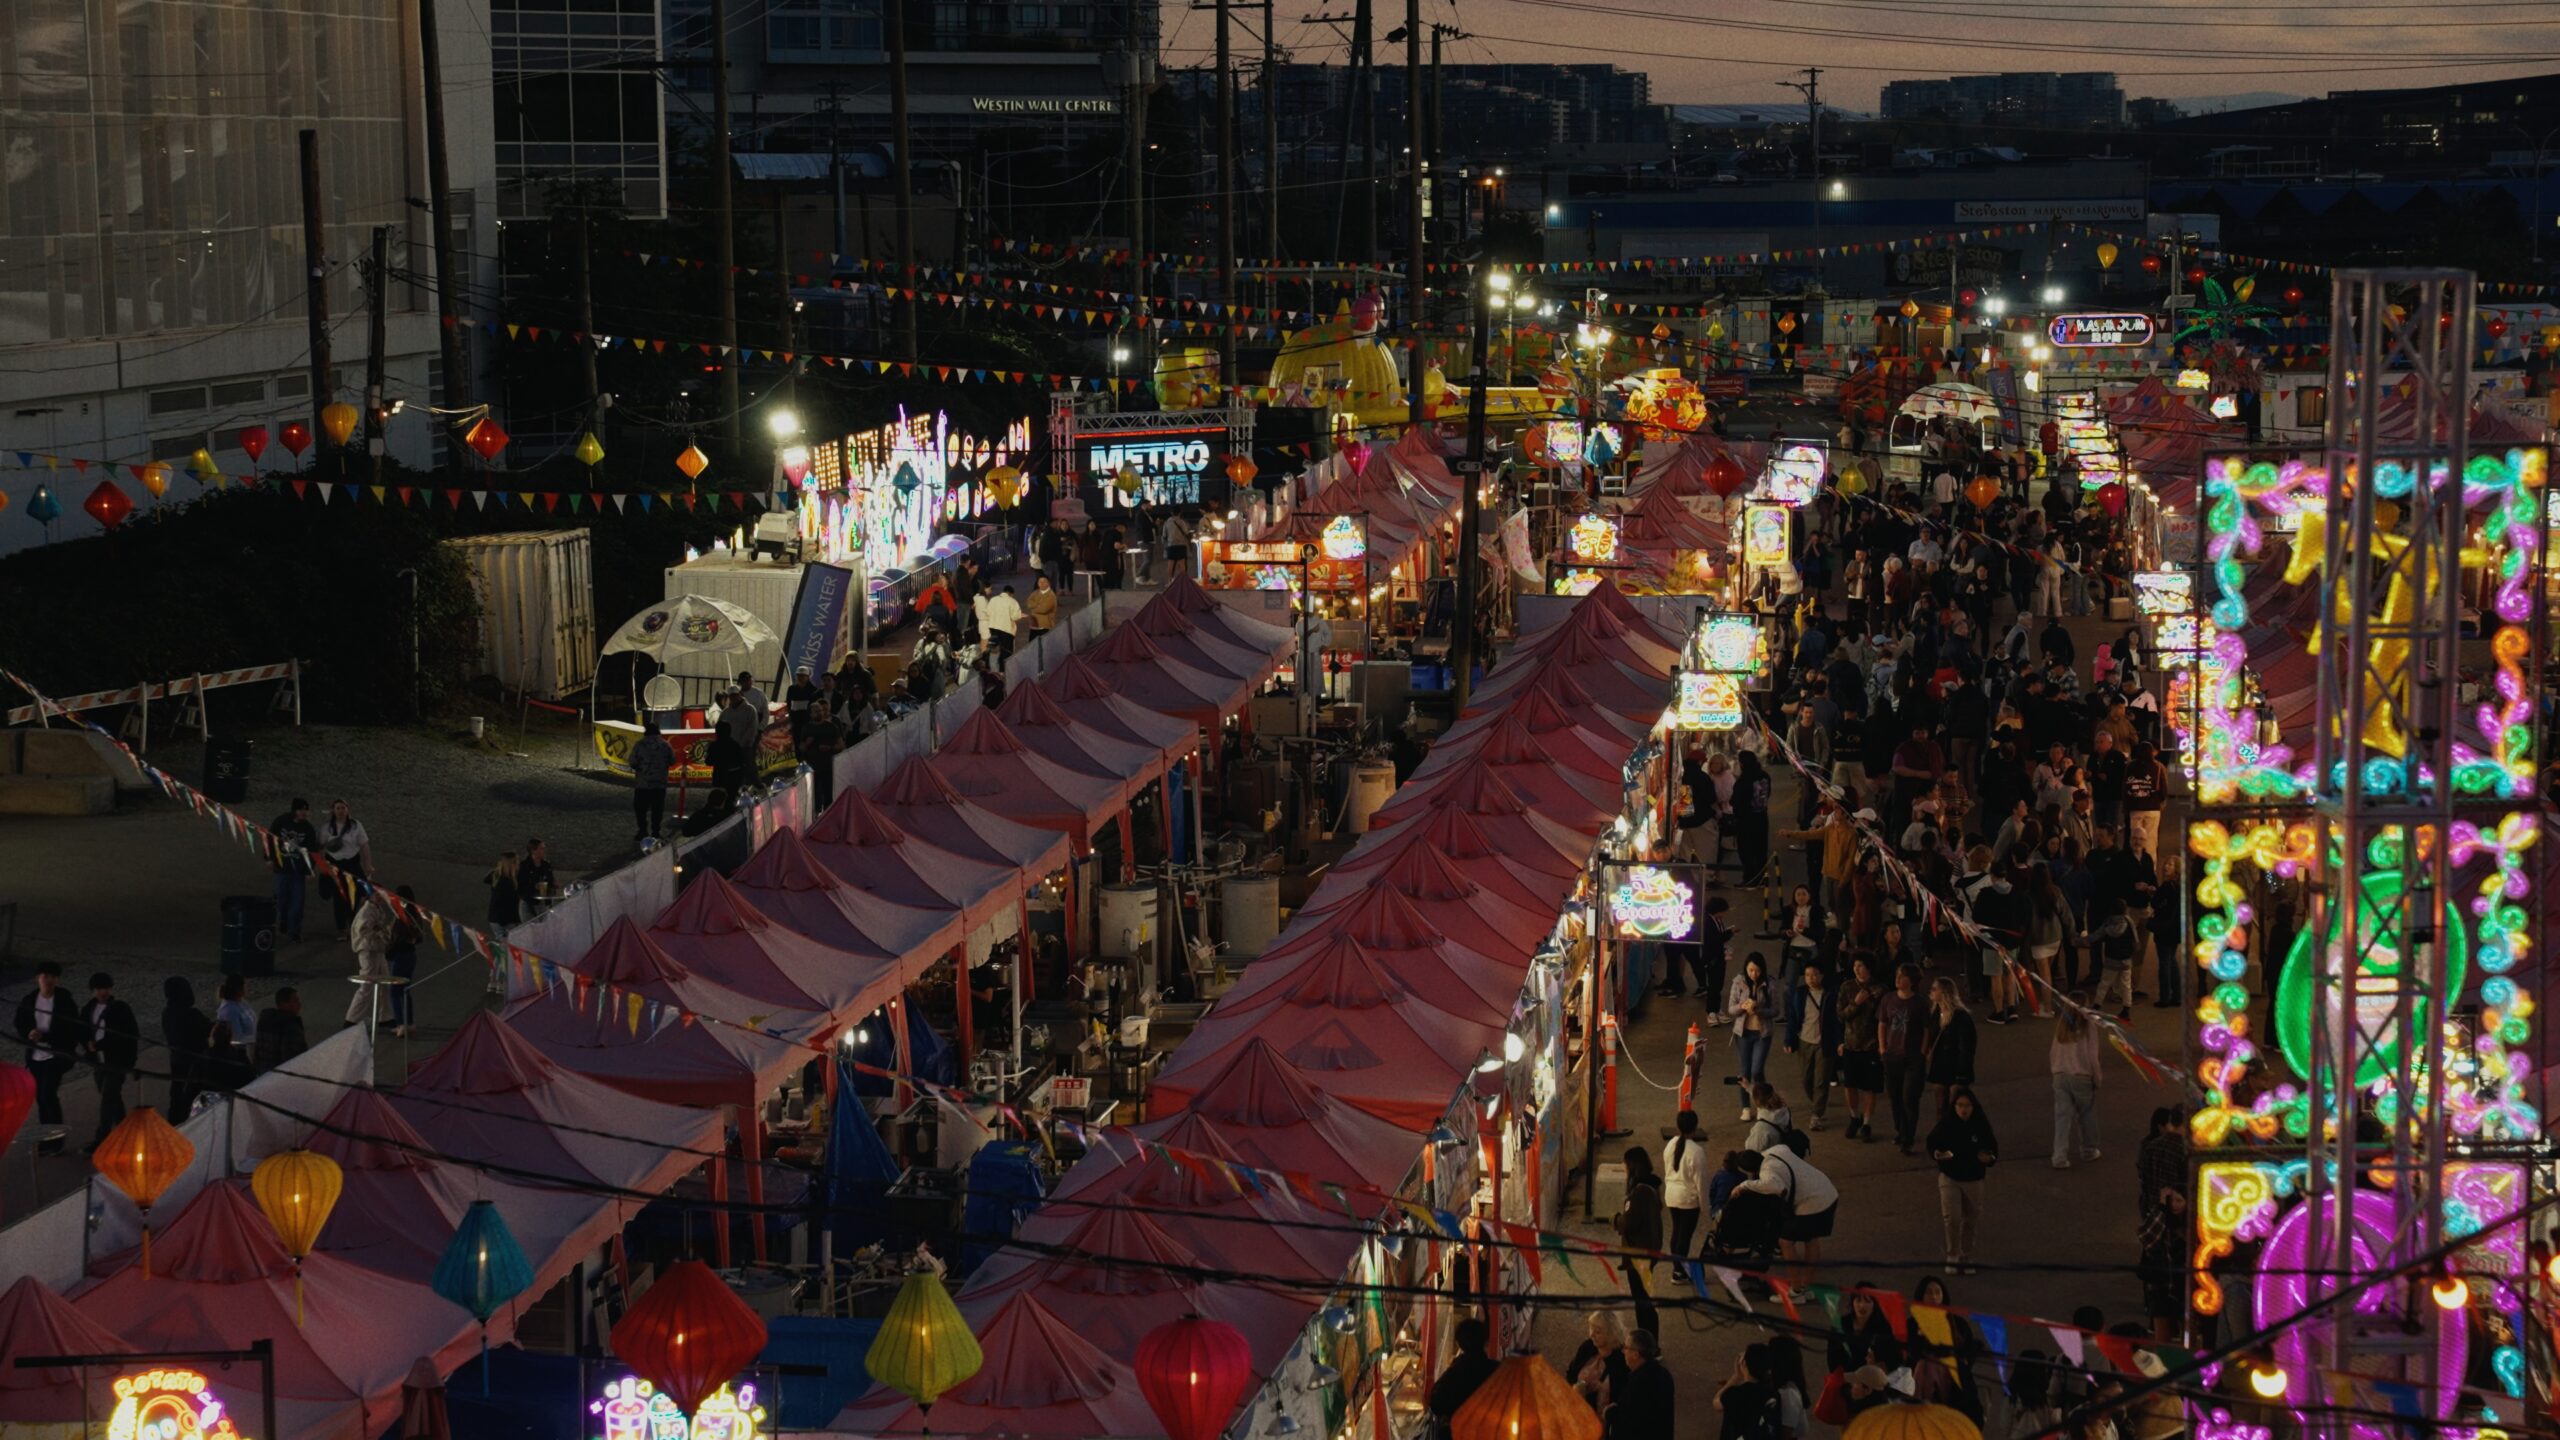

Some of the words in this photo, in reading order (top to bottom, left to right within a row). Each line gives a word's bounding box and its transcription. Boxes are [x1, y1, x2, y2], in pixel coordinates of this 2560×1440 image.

[973, 98, 1023, 111] WESTIN
[1028, 100, 1061, 111] WALL
[1065, 100, 1112, 111] CENTRE
[1960, 203, 2026, 217] Steveston
[1091, 440, 1210, 474] METRO
[1098, 474, 1199, 509] TOWN
[812, 575, 838, 627] WATER
